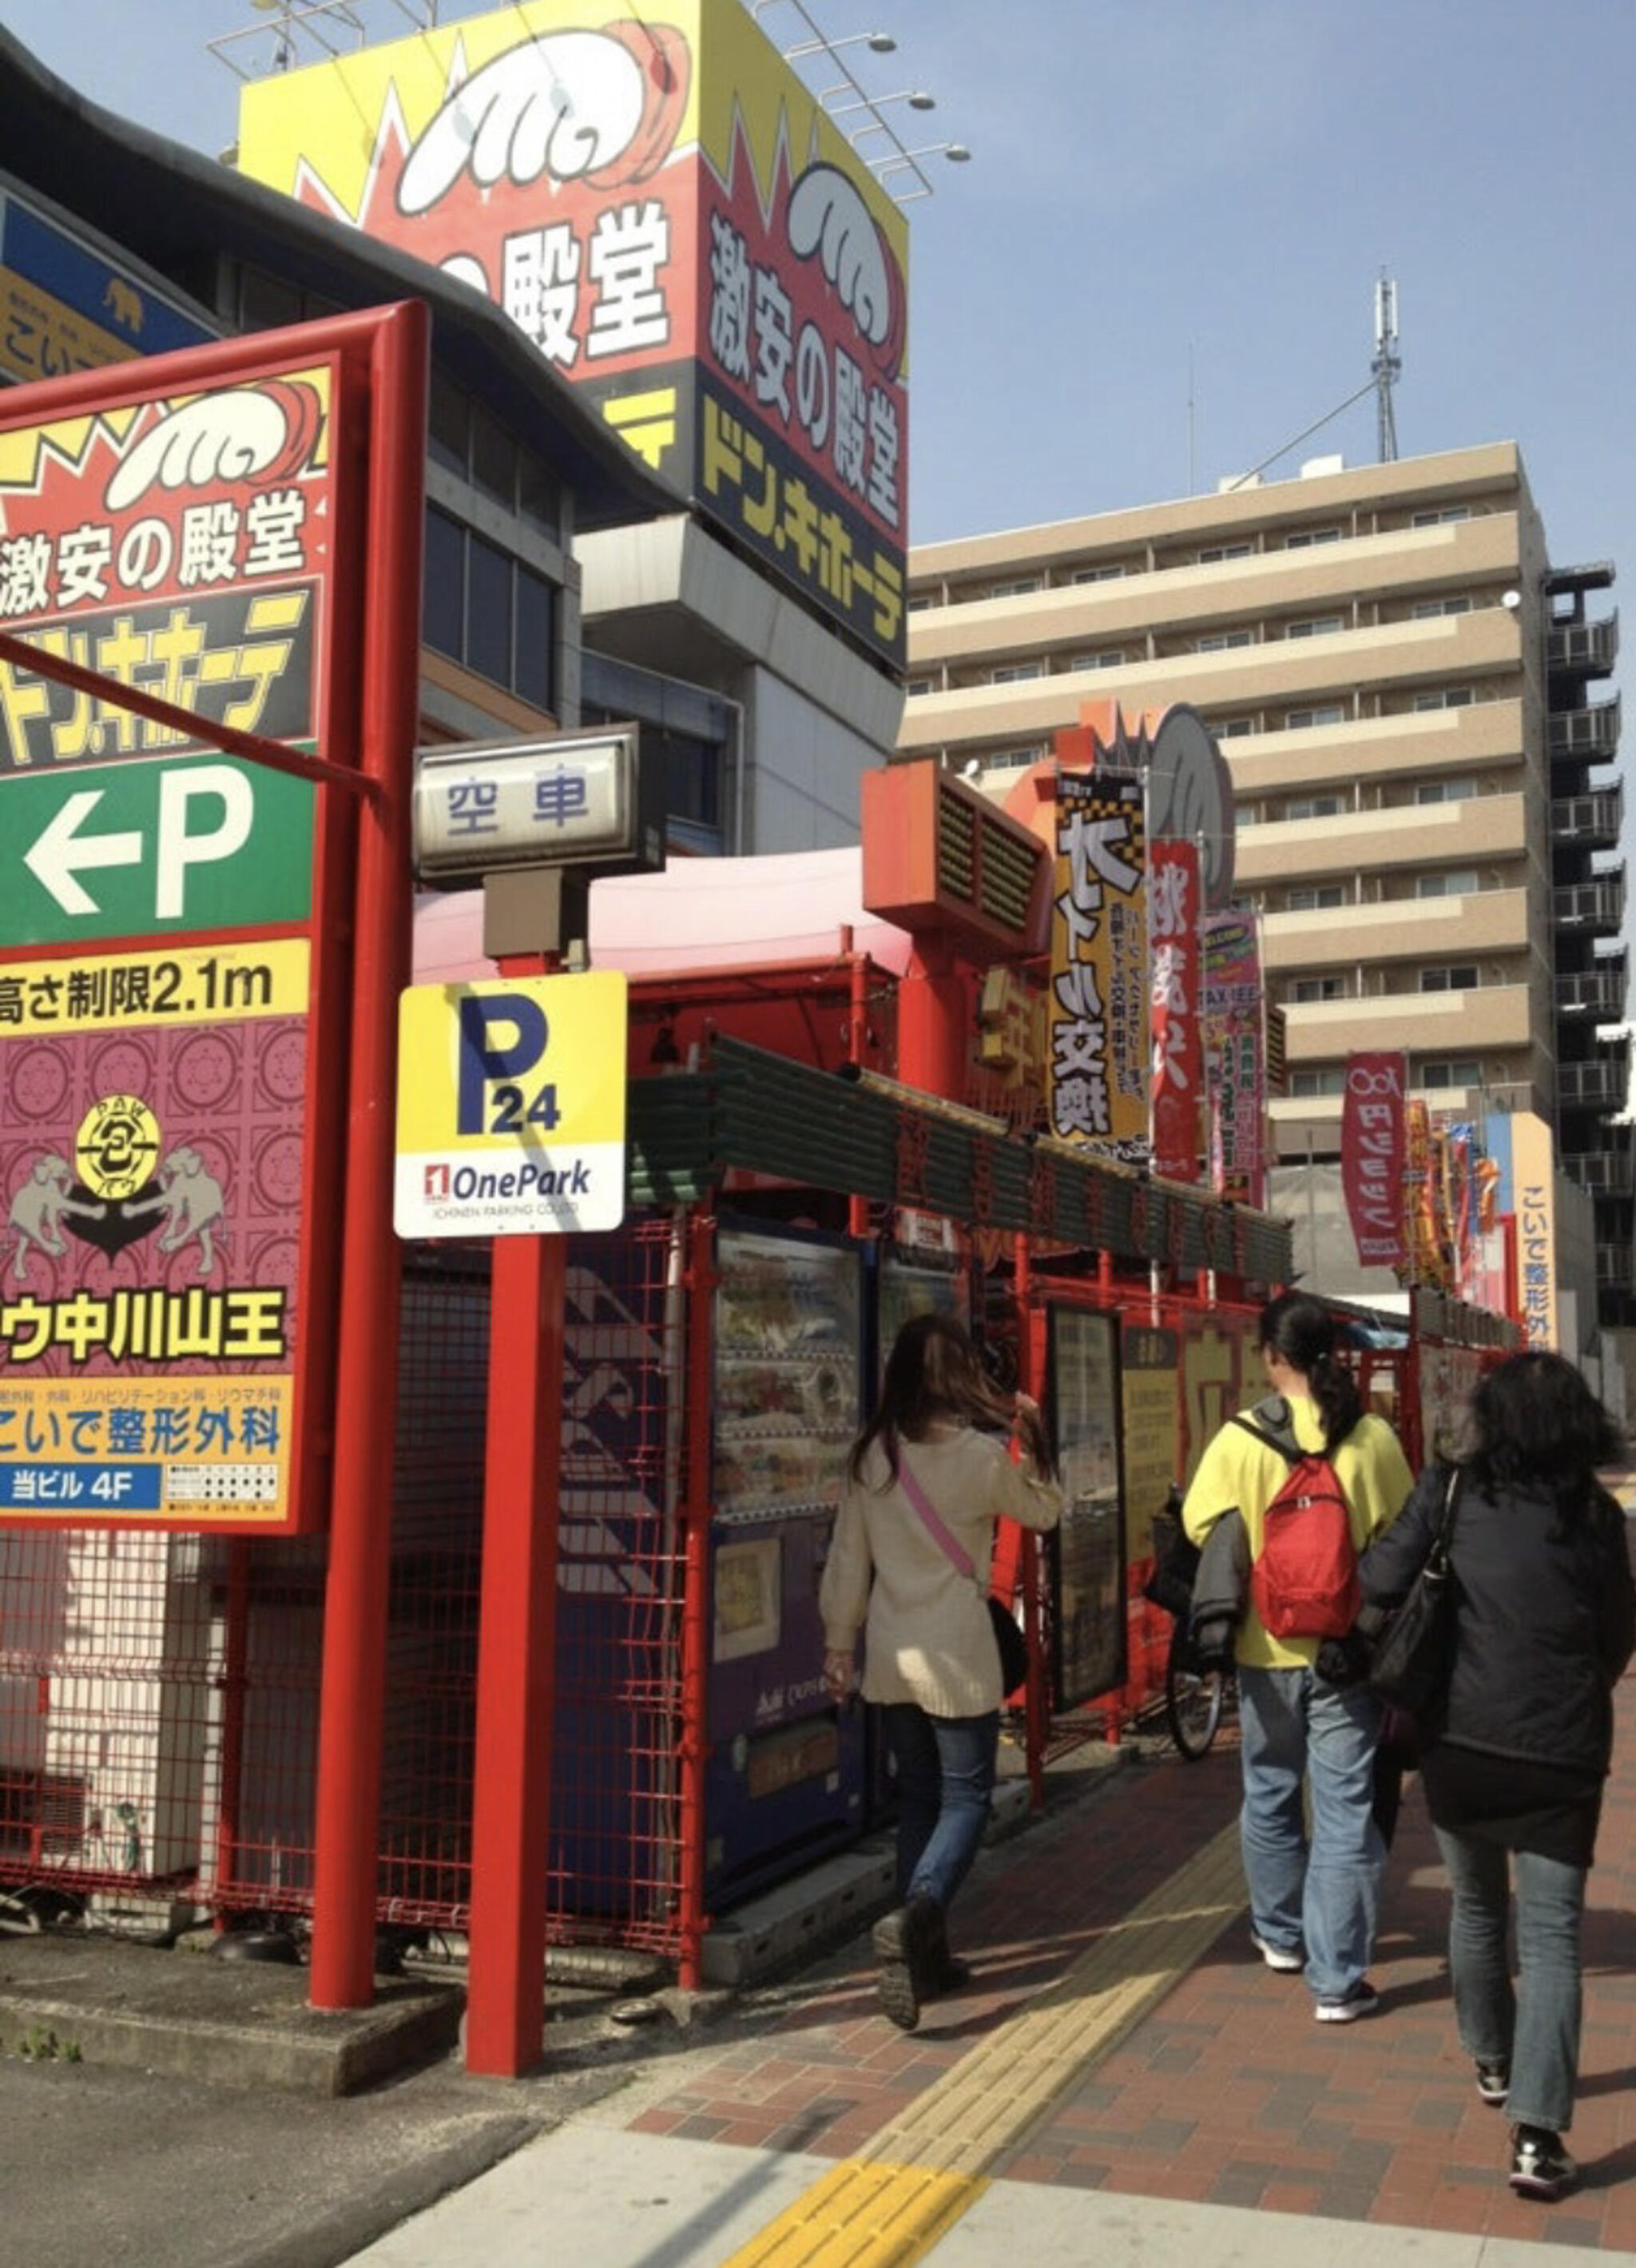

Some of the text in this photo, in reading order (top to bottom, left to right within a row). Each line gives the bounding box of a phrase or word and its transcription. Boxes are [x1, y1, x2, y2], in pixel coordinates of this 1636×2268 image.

[439, 201, 670, 367] 殿堂
[709, 210, 900, 529] 激安の殿堂
[0, 489, 306, 617] 激安の殿堂
[156, 764, 254, 919] P
[0, 958, 272, 1024] 高さ制限2.1m
[457, 993, 549, 1135] P
[490, 1084, 561, 1133] 24
[453, 1159, 591, 1199] OnePark
[0, 1287, 286, 1363] ウ中川山王
[12, 1469, 133, 1501] 当ビル 4F
